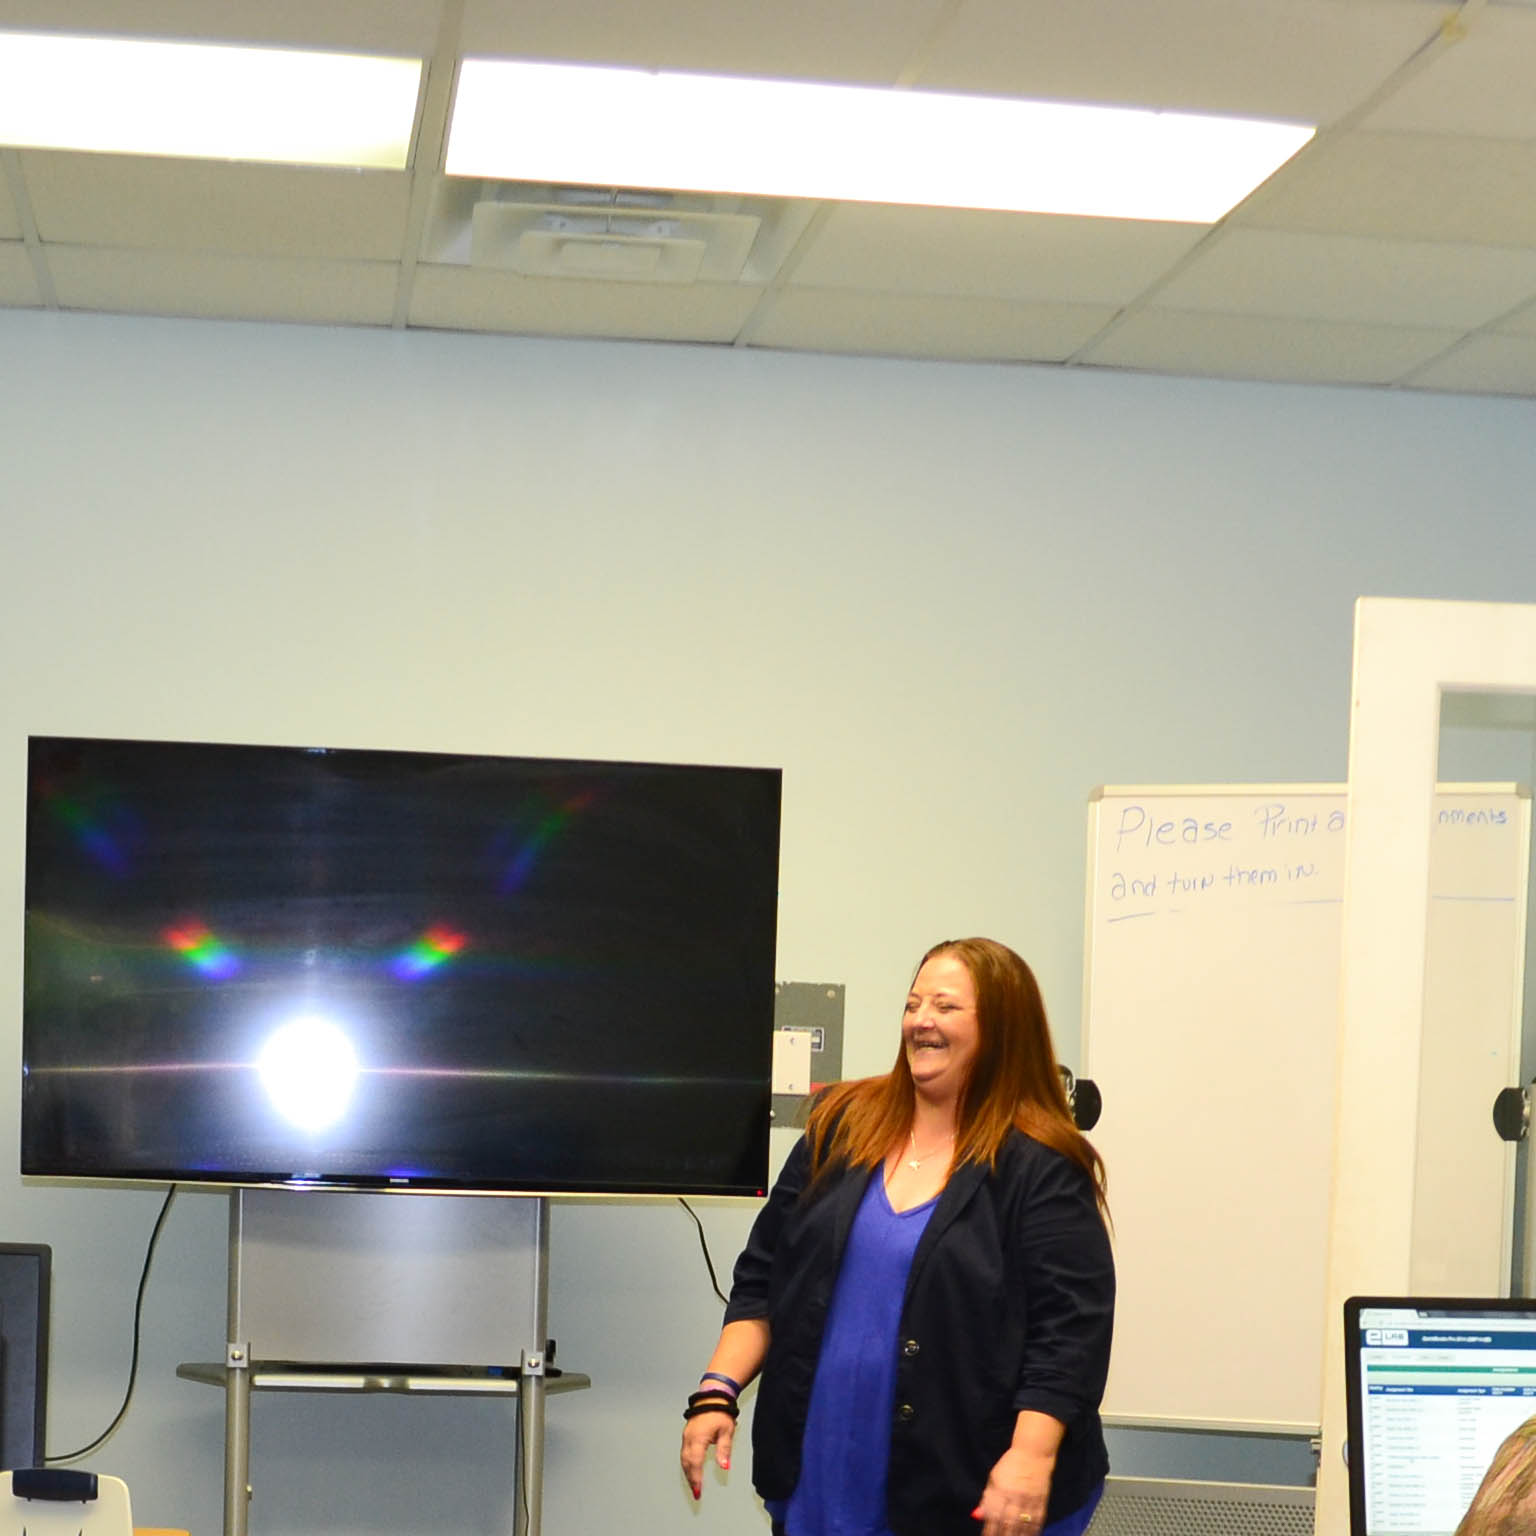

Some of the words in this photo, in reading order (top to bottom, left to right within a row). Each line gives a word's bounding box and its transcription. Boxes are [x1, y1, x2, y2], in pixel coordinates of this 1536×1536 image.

[1116, 804, 1233, 853] Please
[1252, 802, 1318, 839] Print
[1437, 807, 1509, 826] nments
[1111, 871, 1157, 901] and
